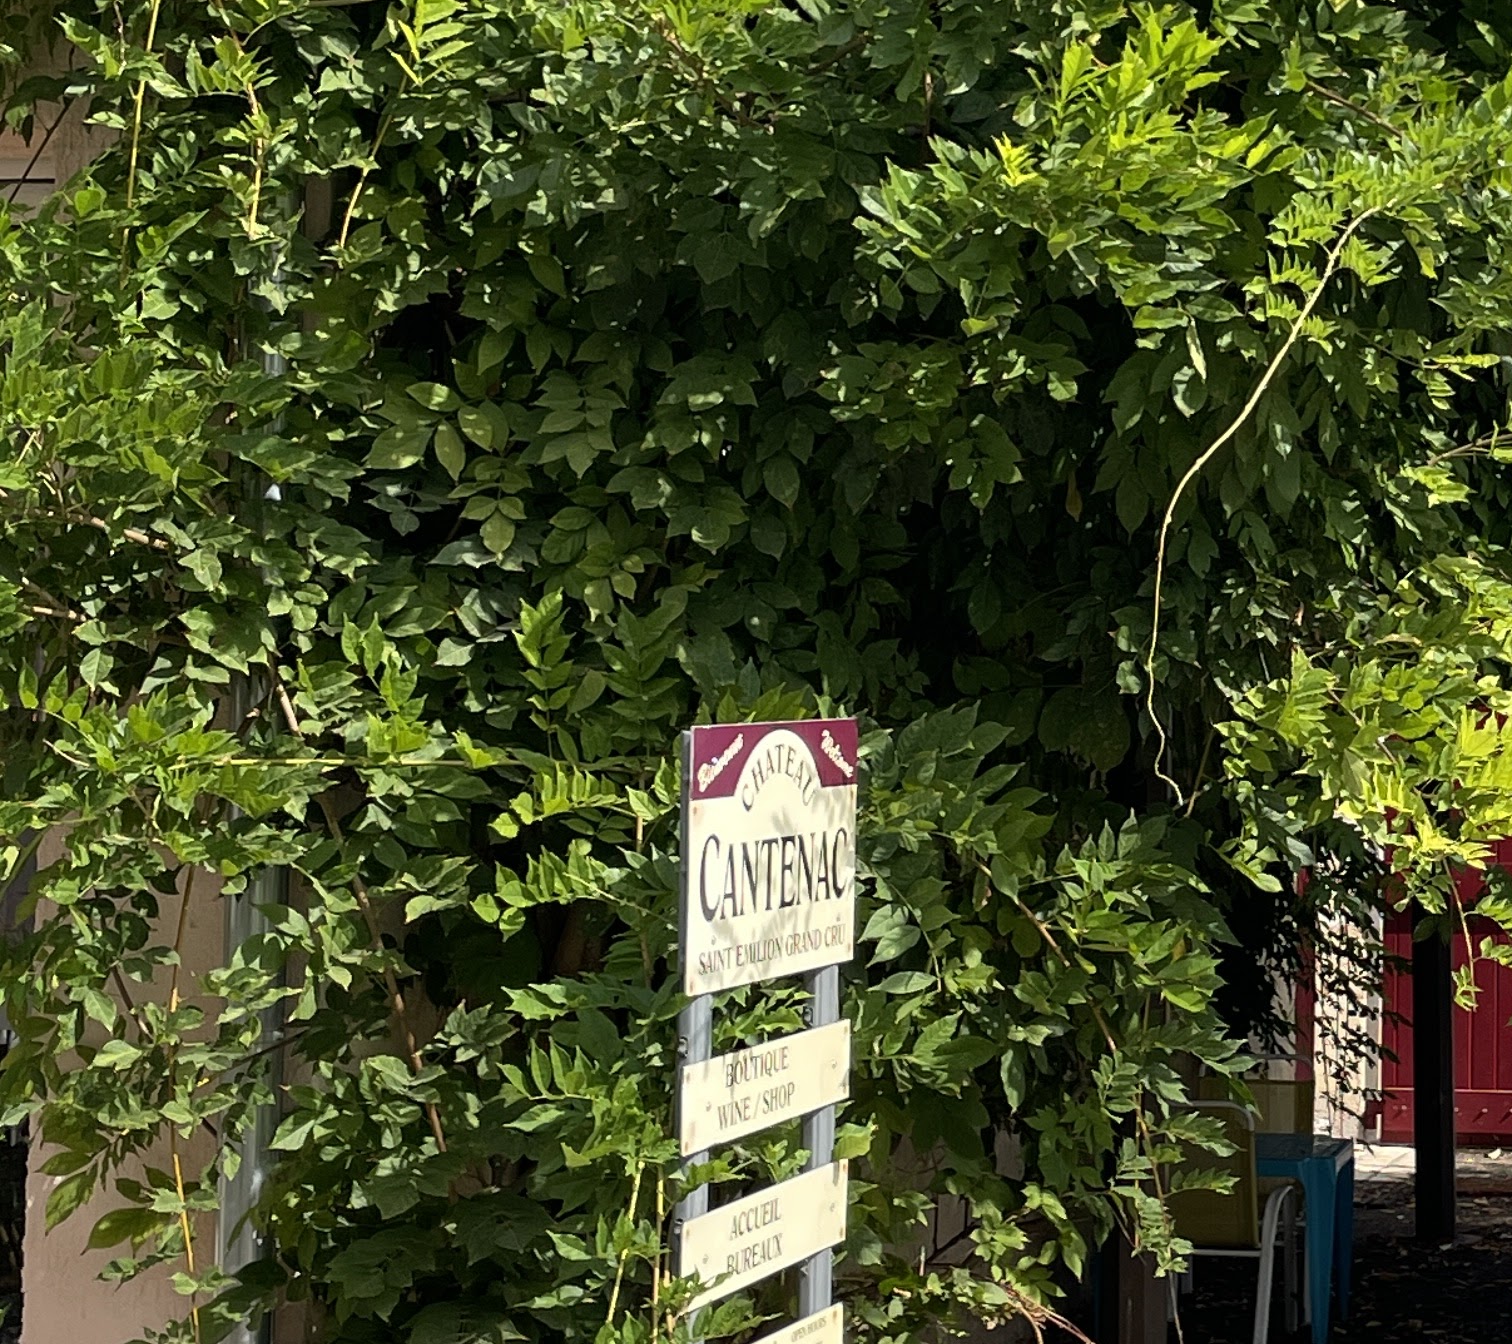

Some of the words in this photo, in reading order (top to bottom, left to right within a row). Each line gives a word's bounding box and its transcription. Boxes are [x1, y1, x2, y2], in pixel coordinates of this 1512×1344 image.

[742, 743, 817, 812] CHATEAU
[699, 827, 848, 922] CANTENAC
[698, 946, 733, 976] SAINT
[735, 937, 785, 967] EMILION
[785, 928, 823, 957] GRAND
[824, 923, 847, 948] CRU
[725, 1045, 789, 1089] BOUTIQUE
[717, 1096, 752, 1131] WINE
[762, 1081, 796, 1115] SHOP
[729, 1197, 782, 1241] ACCUEIL
[726, 1232, 784, 1275] BUREAUX
